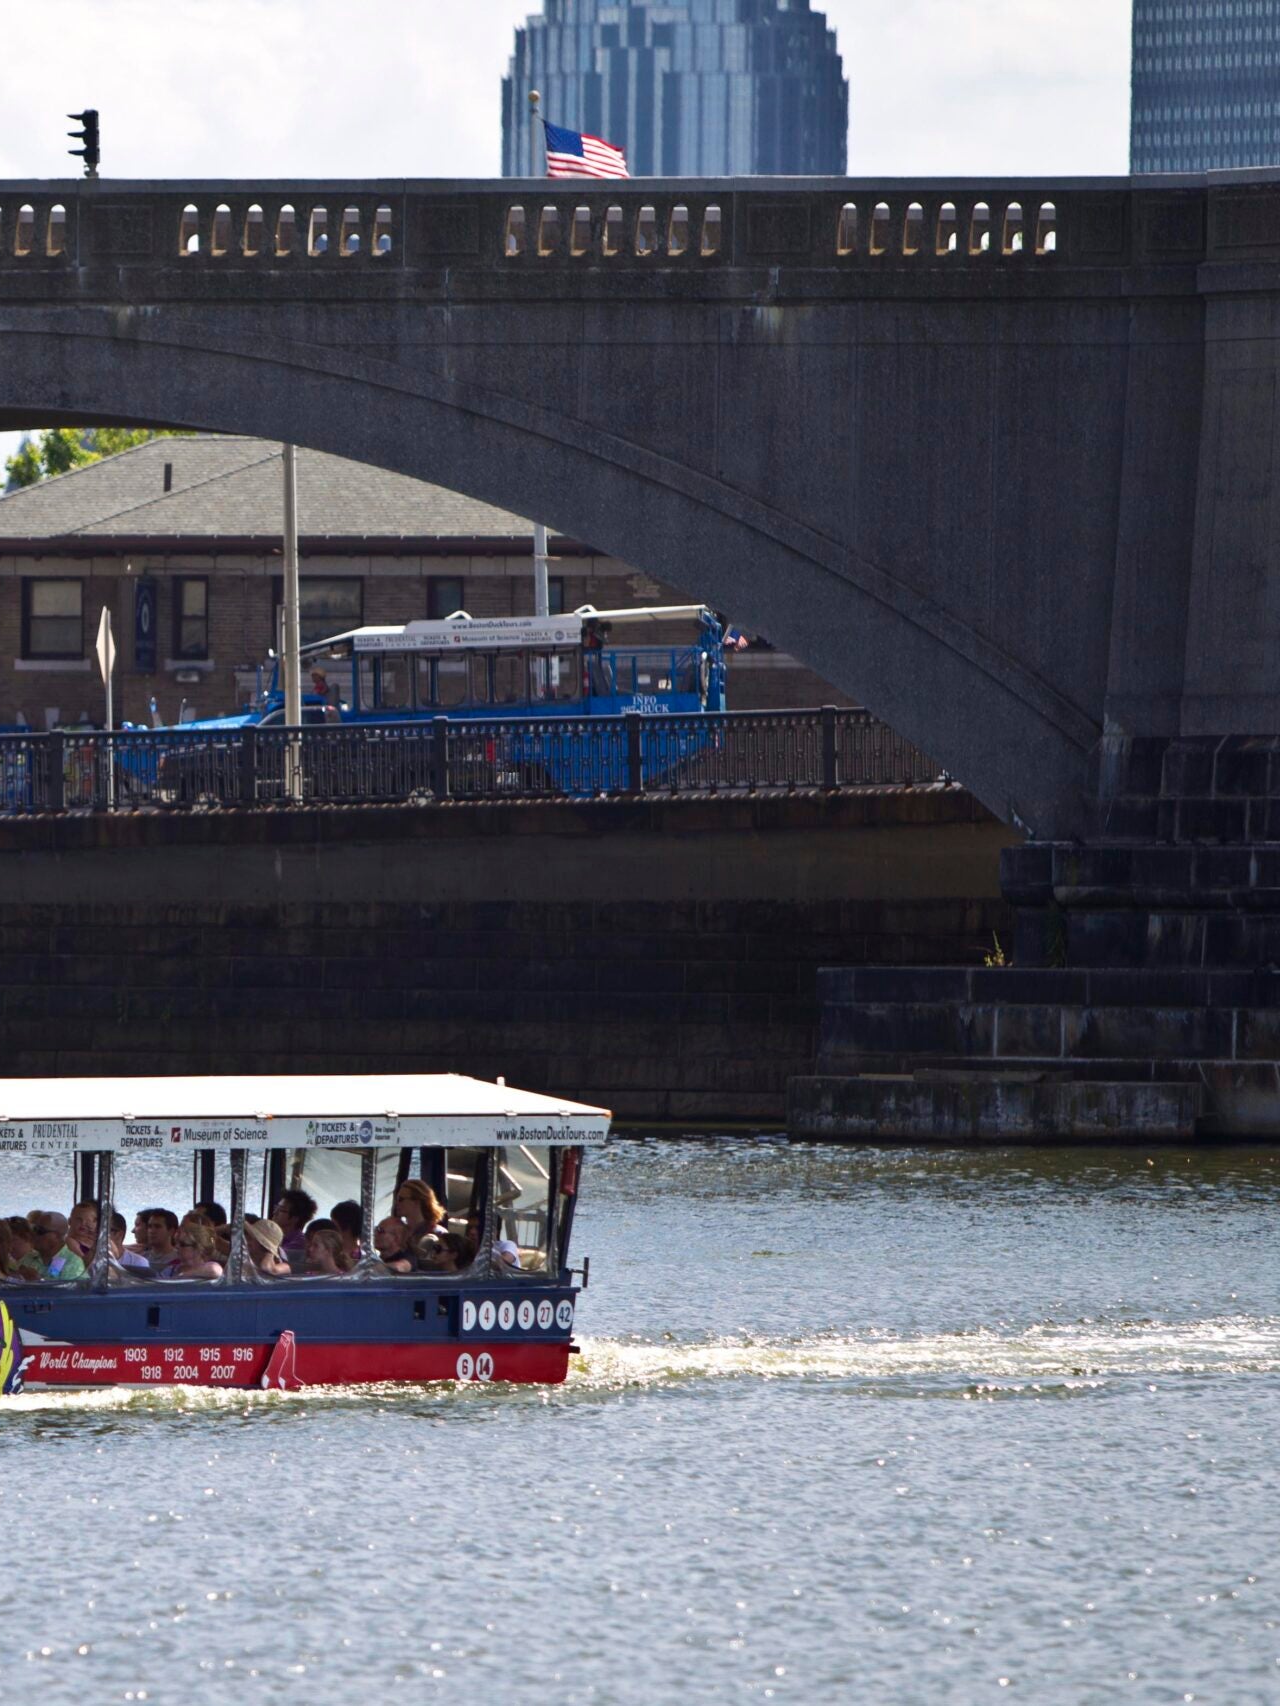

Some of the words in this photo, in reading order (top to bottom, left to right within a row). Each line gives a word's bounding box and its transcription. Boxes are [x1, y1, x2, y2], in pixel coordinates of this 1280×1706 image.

[633, 696, 657, 704] INFO
[18, 1128, 24, 1138] &
[32, 1124, 78, 1138] PRUDENTIAL
[125, 1125, 151, 1135] TICKETS
[154, 1125, 160, 1135] &
[321, 1123, 346, 1132] TICKETS
[349, 1122, 355, 1132] &
[496, 1126, 604, 1140] www.BostonDuckTours.com
[184, 1128, 220, 1141] Museum
[223, 1127, 232, 1140] of
[233, 1127, 267, 1140] Science
[317, 1134, 359, 1145] DEPARTURES
[32, 1141, 78, 1149] CENTER
[120, 1138, 163, 1148] DEPARTURES
[484, 1307, 489, 1323] 4
[504, 1307, 509, 1323] 8
[523, 1307, 528, 1323] 9
[540, 1307, 550, 1322] 27
[558, 1307, 571, 1322] 42
[124, 1348, 147, 1362] 1903
[163, 1348, 184, 1362] 1912
[199, 1348, 220, 1361] 1915
[232, 1348, 253, 1361] 1916
[39, 1352, 69, 1369] World
[71, 1352, 117, 1373] Champions
[462, 1359, 468, 1375] 6
[479, 1358, 490, 1375] 14
[140, 1366, 161, 1379] 1918
[173, 1366, 198, 1379] 2004
[210, 1366, 235, 1379] 2007
